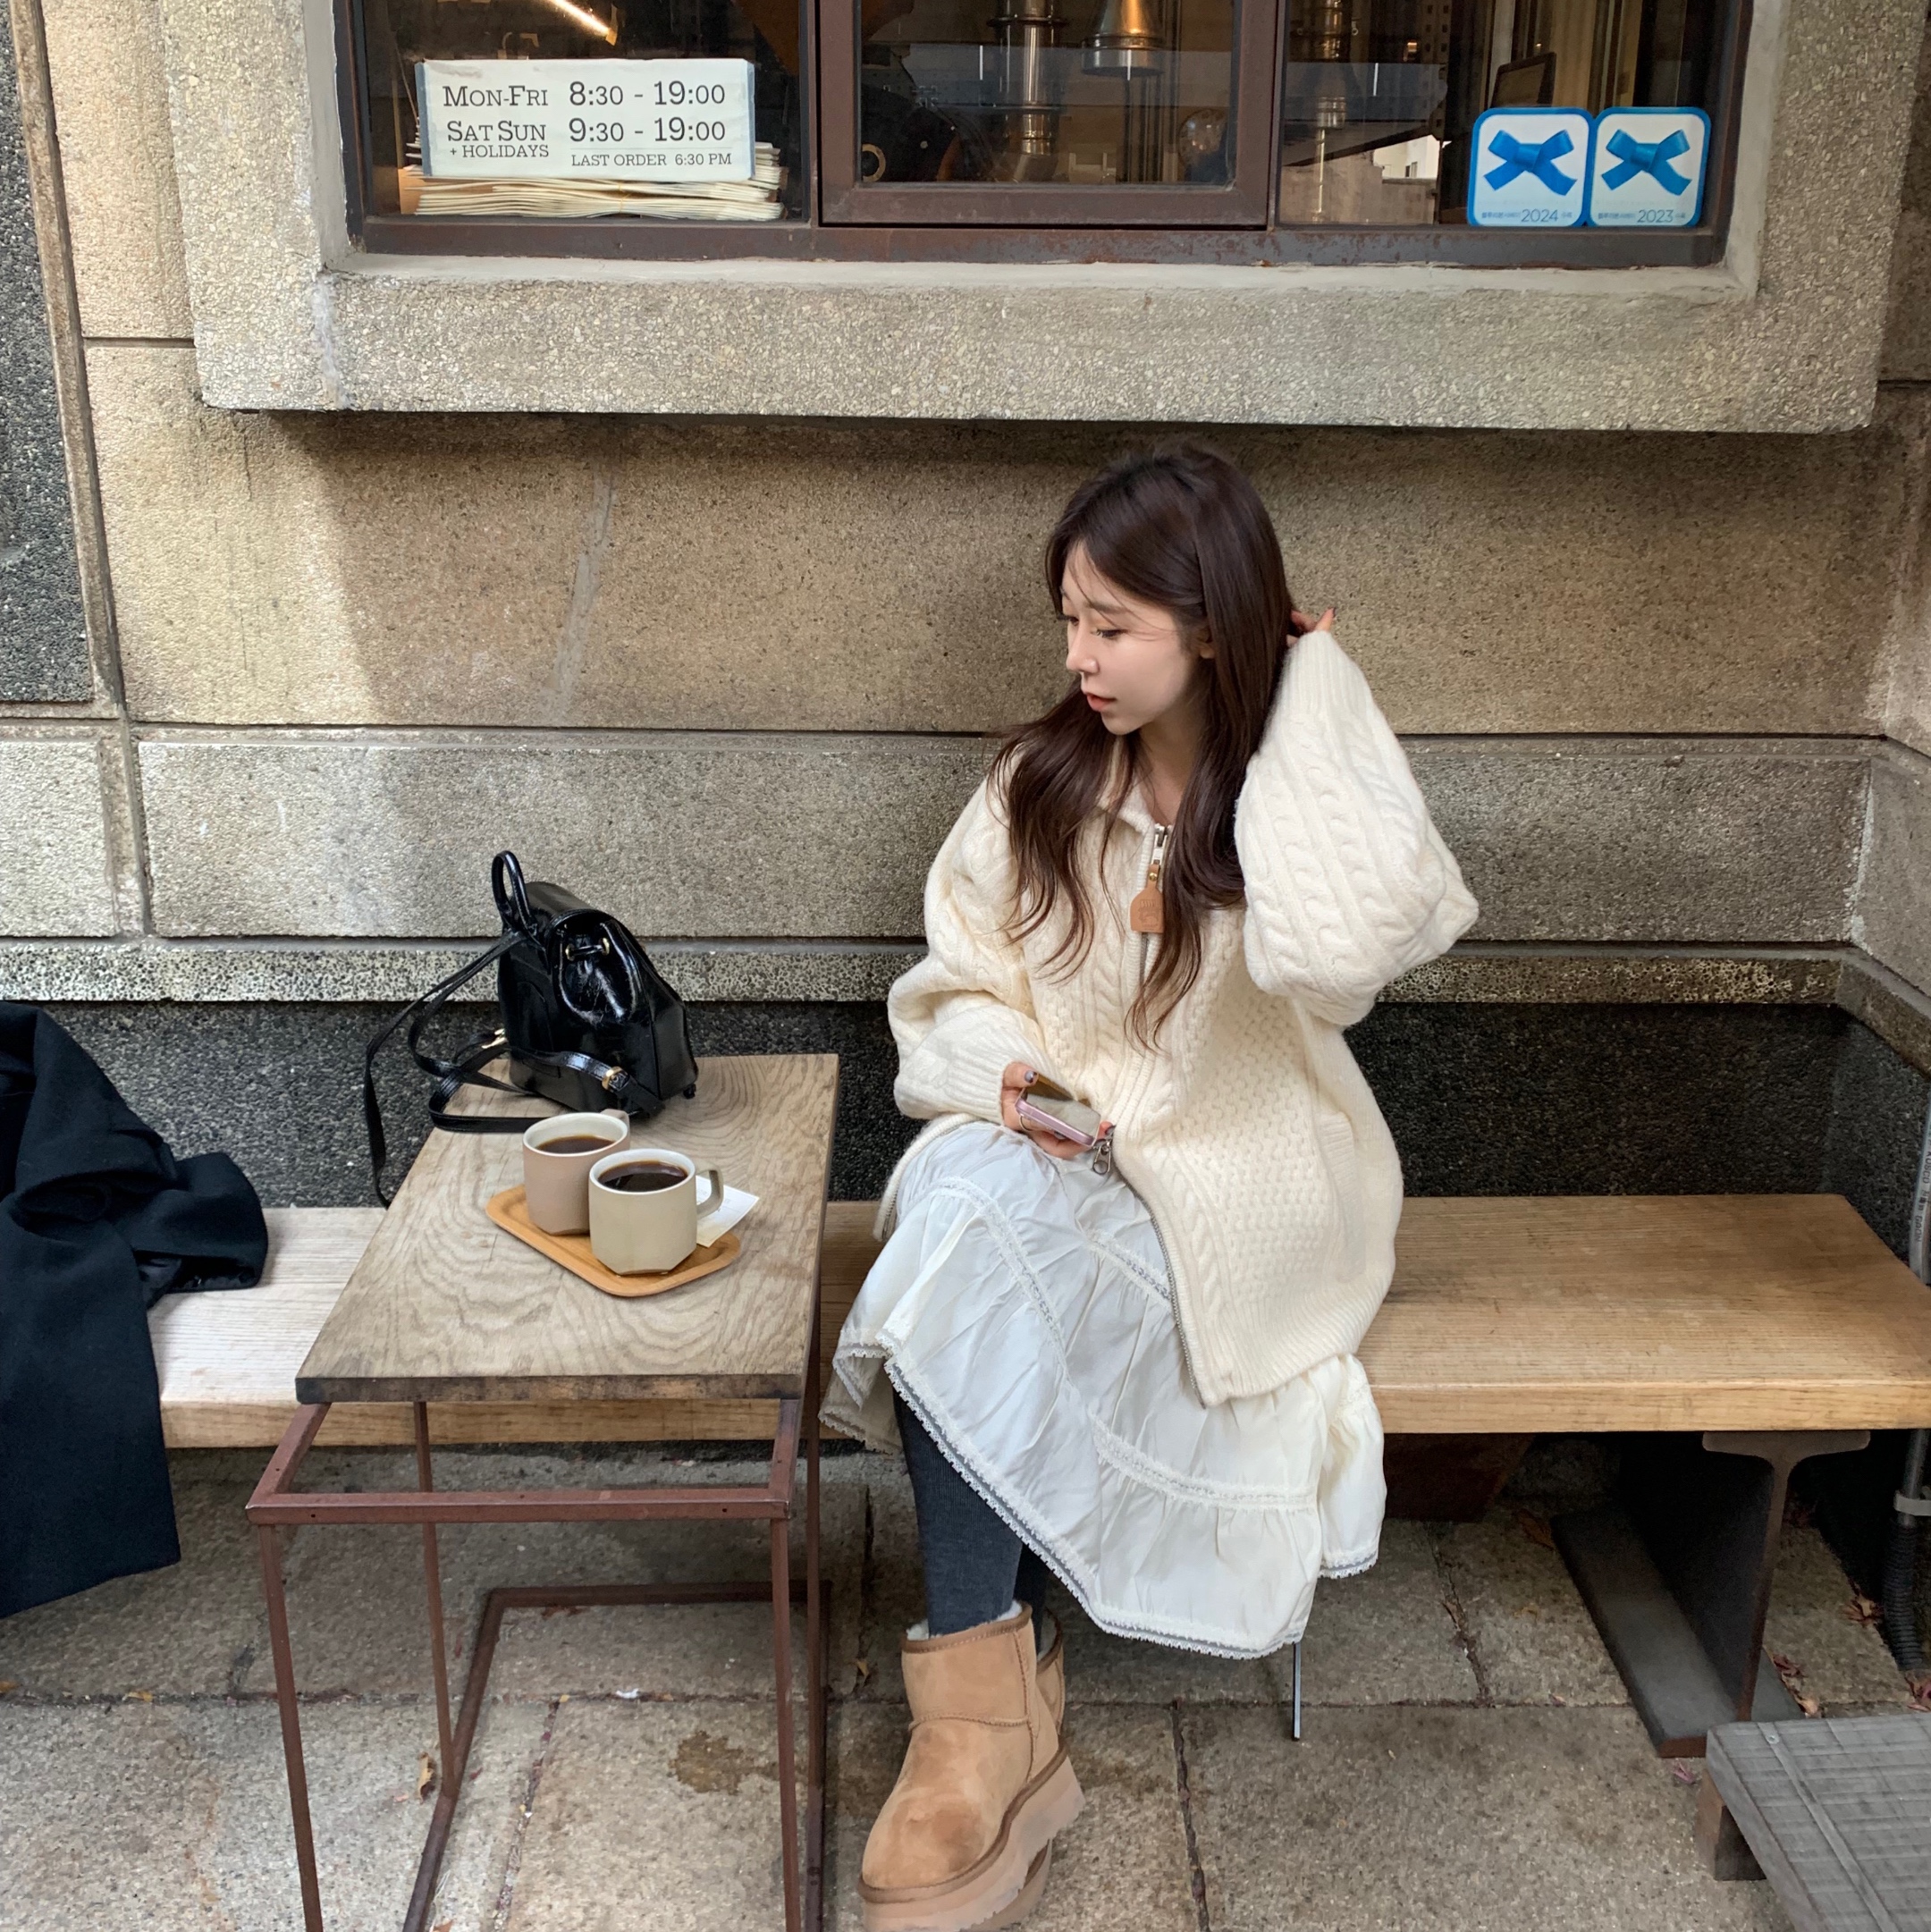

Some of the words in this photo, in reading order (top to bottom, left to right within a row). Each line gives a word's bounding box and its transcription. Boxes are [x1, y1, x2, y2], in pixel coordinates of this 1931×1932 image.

[569, 80, 624, 105] 8:30
[654, 80, 725, 105] 19:00
[569, 117, 624, 142] 9:30
[654, 117, 726, 142] 19:00
[462, 144, 549, 158] HOLIDAYS
[571, 154, 610, 166] LAST
[613, 154, 667, 166] ORDER
[675, 153, 704, 165] 6:30
[709, 153, 732, 165] PM
[1521, 208, 1558, 223] 2024
[1636, 209, 1674, 224] 2023
